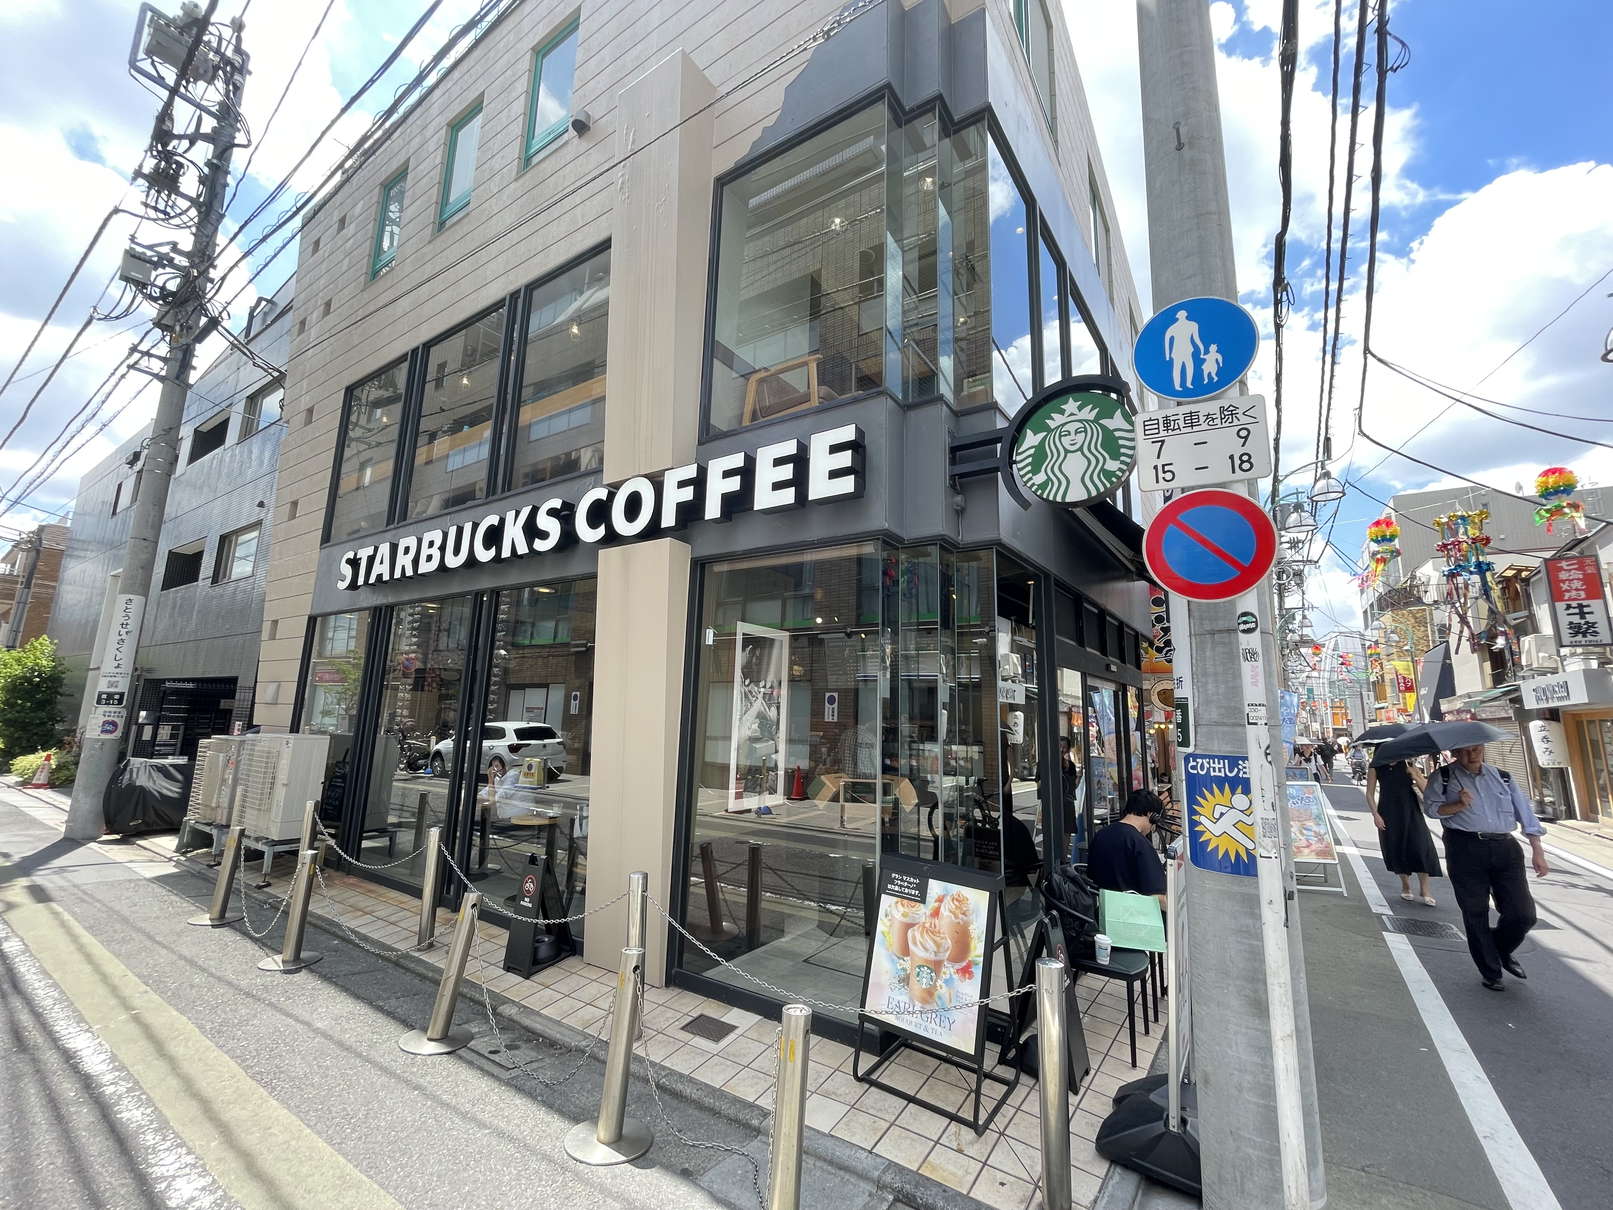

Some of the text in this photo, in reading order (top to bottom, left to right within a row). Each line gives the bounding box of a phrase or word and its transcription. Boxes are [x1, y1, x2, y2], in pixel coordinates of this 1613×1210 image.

[1143, 404, 1257, 436] 自転車を除く
[1151, 439, 1165, 460] 7
[1236, 428, 1251, 448] 9
[1152, 463, 1176, 485] 15
[1228, 452, 1255, 475] 18
[336, 423, 863, 591] STARBUCKS COFFEE
[1564, 603, 1600, 639] 牛繁
[920, 1011, 956, 1031] GREY
